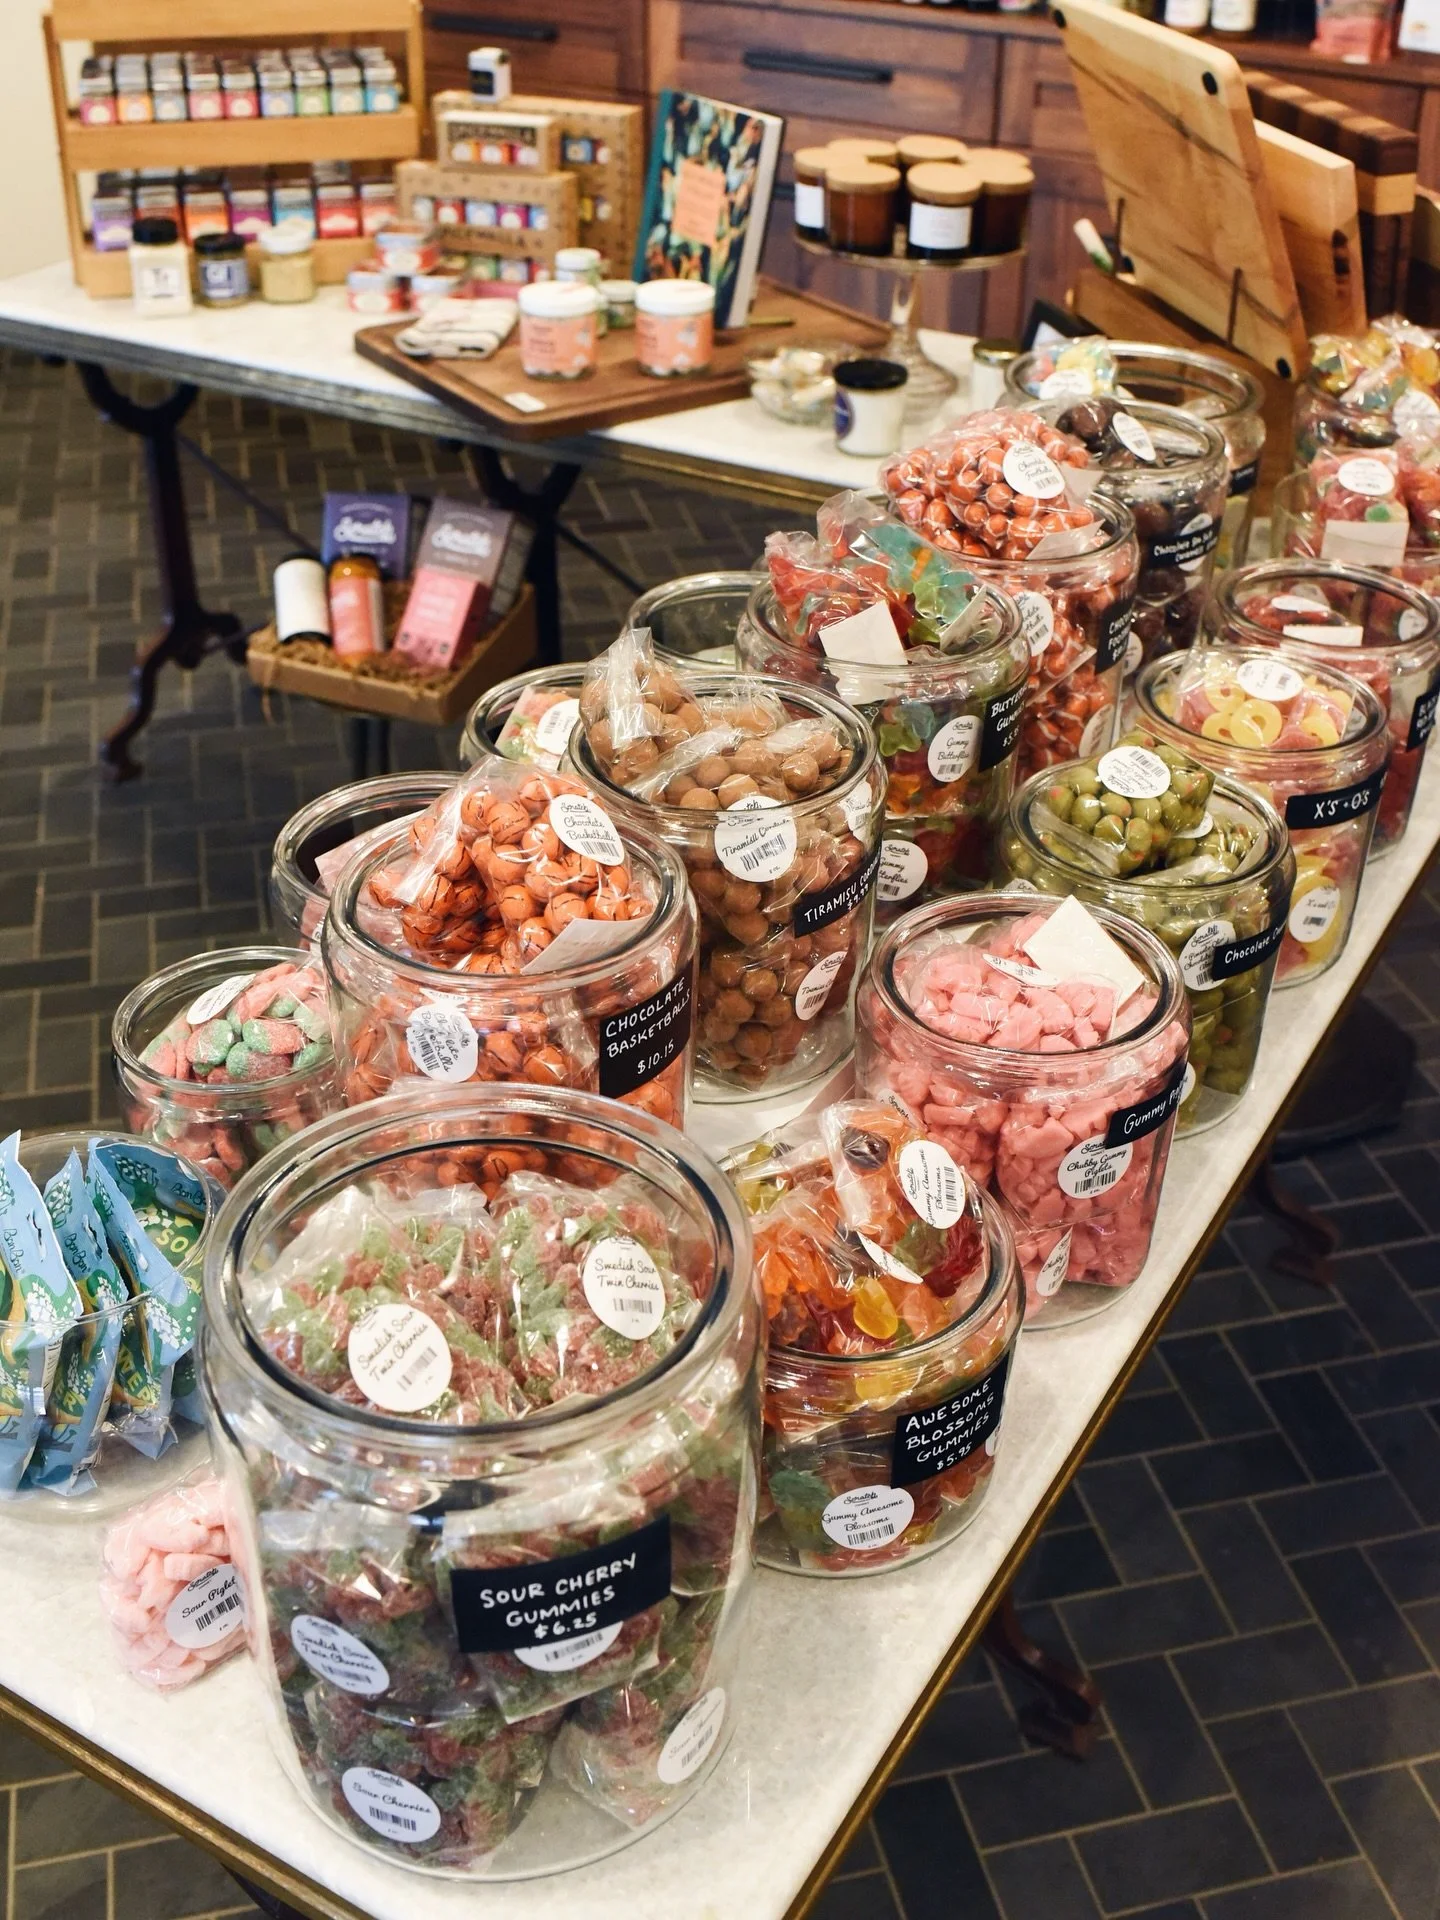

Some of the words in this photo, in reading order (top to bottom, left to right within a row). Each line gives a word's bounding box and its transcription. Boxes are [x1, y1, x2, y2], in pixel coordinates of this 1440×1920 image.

[722, 833, 759, 856] Tiramisu
[804, 882, 857, 922] TIRAMISU
[1224, 936, 1270, 964] Chocolate
[606, 977, 685, 1038] CHOCOLATE
[606, 988, 691, 1058] BASKETBALLS
[637, 1039, 674, 1074] $10.15
[1124, 1101, 1166, 1134] Gummy
[1067, 1158, 1098, 1171] Chubby
[1100, 1150, 1127, 1164] Gummy
[1085, 1163, 1112, 1177] Piglets
[595, 1258, 635, 1271] Swedish
[597, 1275, 623, 1287] Twin
[626, 1275, 659, 1290] Cherries
[906, 1378, 991, 1433] AWESOME
[906, 1392, 994, 1450] BLOSSOMS
[916, 1412, 989, 1462] GUMMIES
[937, 1442, 972, 1470] $5.95
[822, 1512, 857, 1524] Gummy
[860, 1499, 904, 1516] Awesome
[844, 1516, 889, 1532] Blossoms
[480, 1583, 545, 1608] SOUR
[555, 1552, 637, 1596] CHERRY
[182, 1599, 207, 1618] Sour
[506, 1586, 616, 1627] GUMMIES
[534, 1612, 597, 1639] $6.25
[353, 1782, 380, 1798] Sour
[382, 1794, 432, 1813] Cherries
